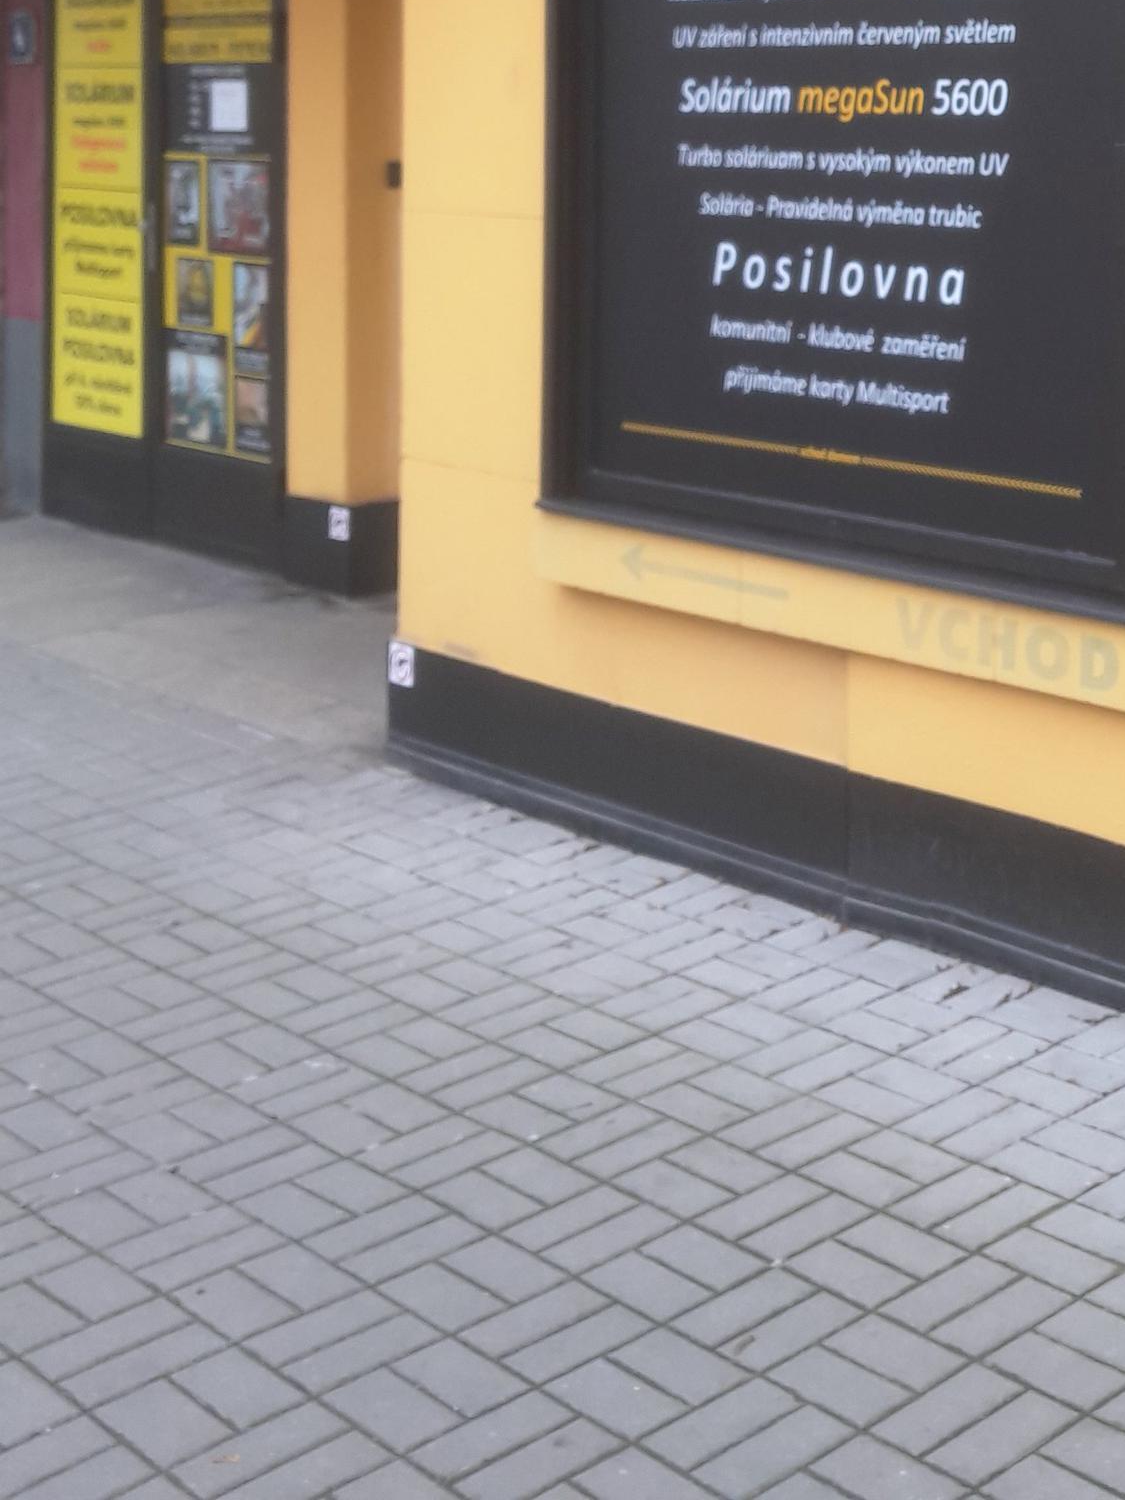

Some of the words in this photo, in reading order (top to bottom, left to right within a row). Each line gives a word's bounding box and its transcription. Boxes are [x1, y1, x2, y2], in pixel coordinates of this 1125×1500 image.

[672, 25, 698, 48] UV
[749, 27, 759, 47] s
[857, 20, 940, 49] červeným
[943, 17, 1016, 45] světlem
[679, 75, 791, 114] Solárium
[797, 77, 924, 123] megaSun
[931, 78, 1008, 116] 5600
[677, 143, 722, 168] Turbo
[805, 151, 815, 171] s
[818, 147, 891, 177] vysokým
[895, 149, 975, 178] výkonem
[979, 152, 1010, 177] UV
[699, 191, 754, 217] Solária
[766, 194, 853, 222] Pravidelná
[857, 198, 925, 228] výměna
[928, 202, 983, 229] trubic
[712, 241, 965, 305] Posilovna
[710, 313, 793, 343] komunitní
[807, 321, 875, 352] klubové
[881, 334, 967, 362] zaměření
[808, 373, 853, 407] karty
[856, 380, 950, 414] Multisport
[897, 594, 1121, 694] VCHOD
